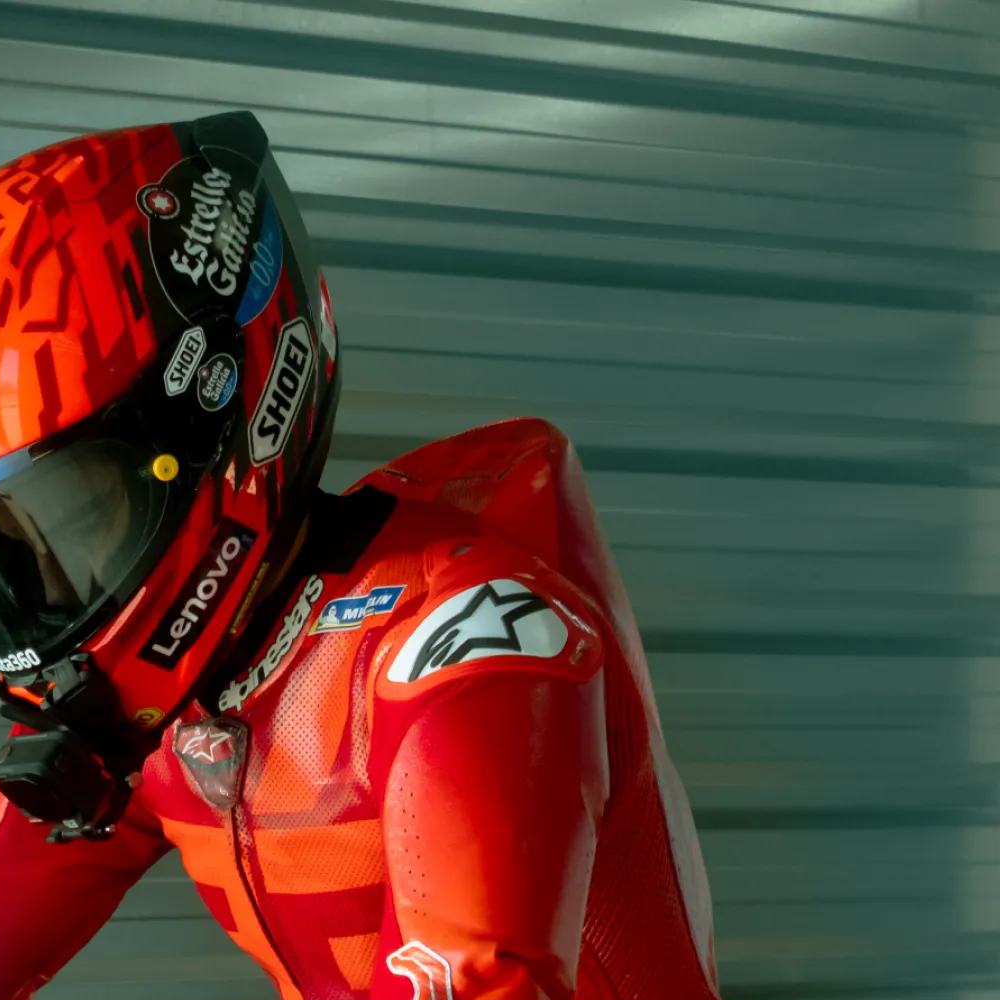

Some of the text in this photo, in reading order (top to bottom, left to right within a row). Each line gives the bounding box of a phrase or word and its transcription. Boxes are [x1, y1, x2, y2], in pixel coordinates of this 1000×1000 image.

[169, 167, 232, 286] Estrella
[205, 190, 257, 296] Galicia
[169, 335, 202, 387] SHOEI
[257, 333, 309, 447] SHOEI
[152, 536, 241, 657] Lenovo
[218, 574, 324, 712] alpinestars
